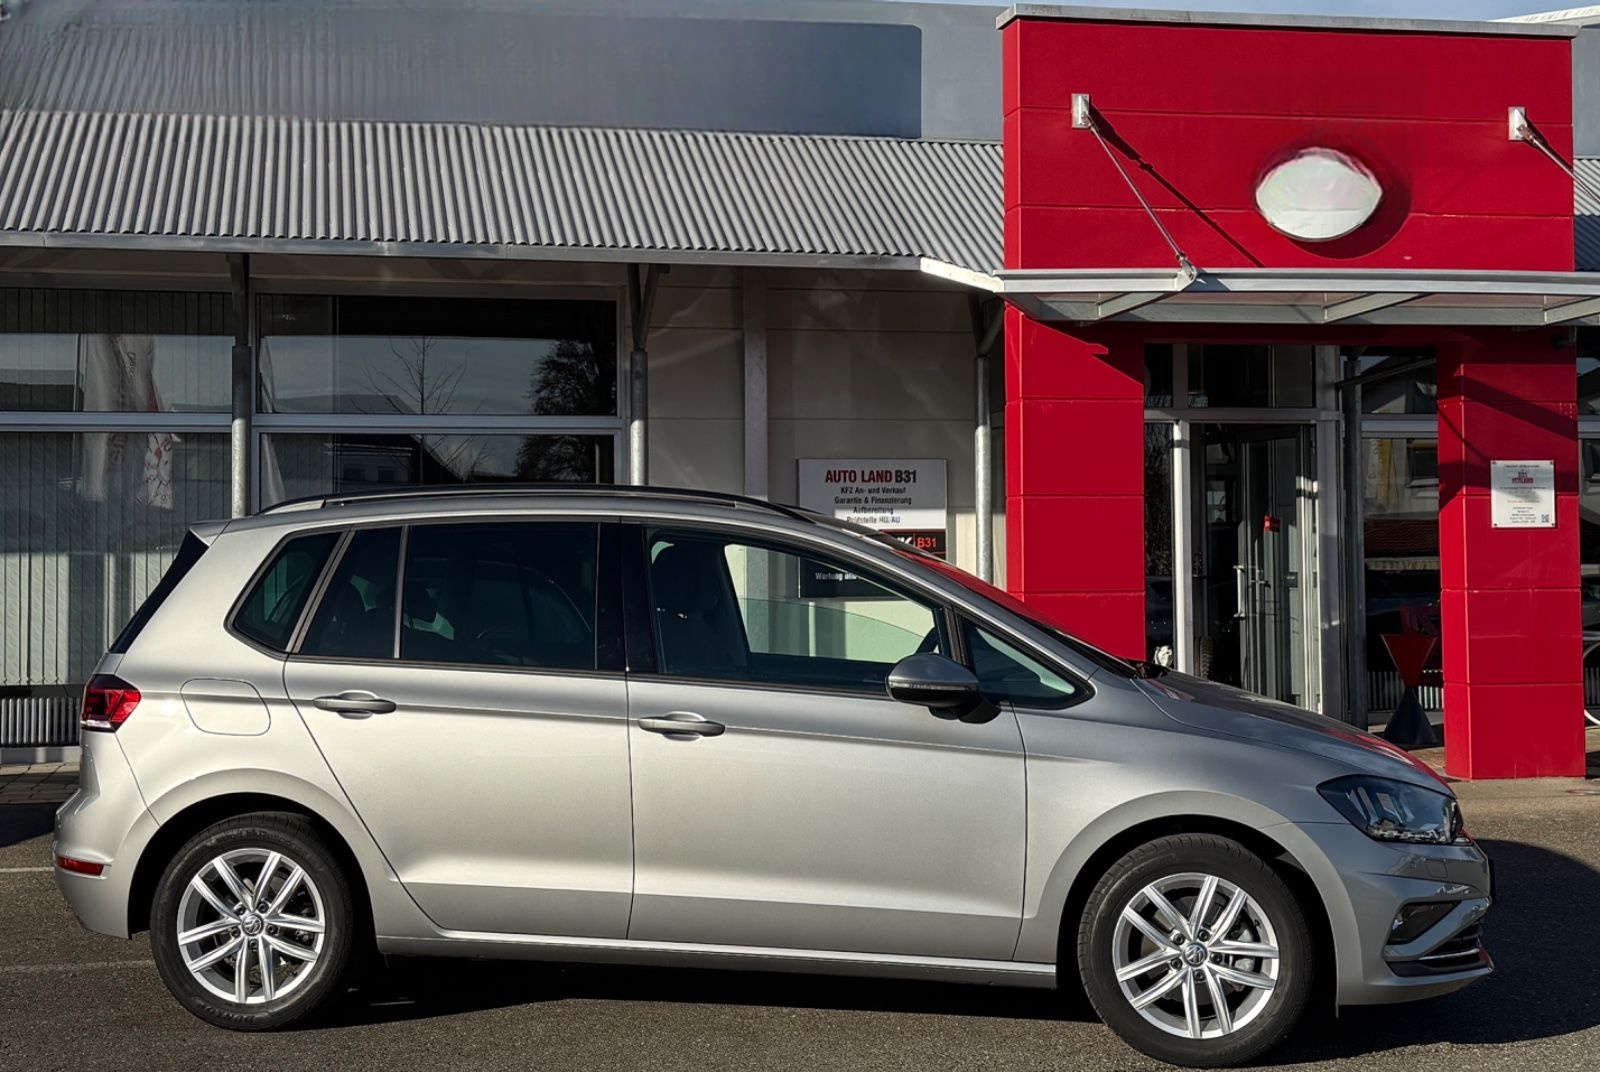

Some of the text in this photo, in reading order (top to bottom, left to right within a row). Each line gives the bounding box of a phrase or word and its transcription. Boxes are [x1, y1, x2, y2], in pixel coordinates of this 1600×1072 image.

[825, 470, 917, 483] AUTO LAND B31
[841, 486, 906, 495] KFZ An- und Verkauf
[834, 496, 912, 506] Garantie & Finanzierung
[853, 506, 894, 515] Aufbereitung
[917, 537, 936, 548] B31
[815, 572, 843, 582] Wartung
